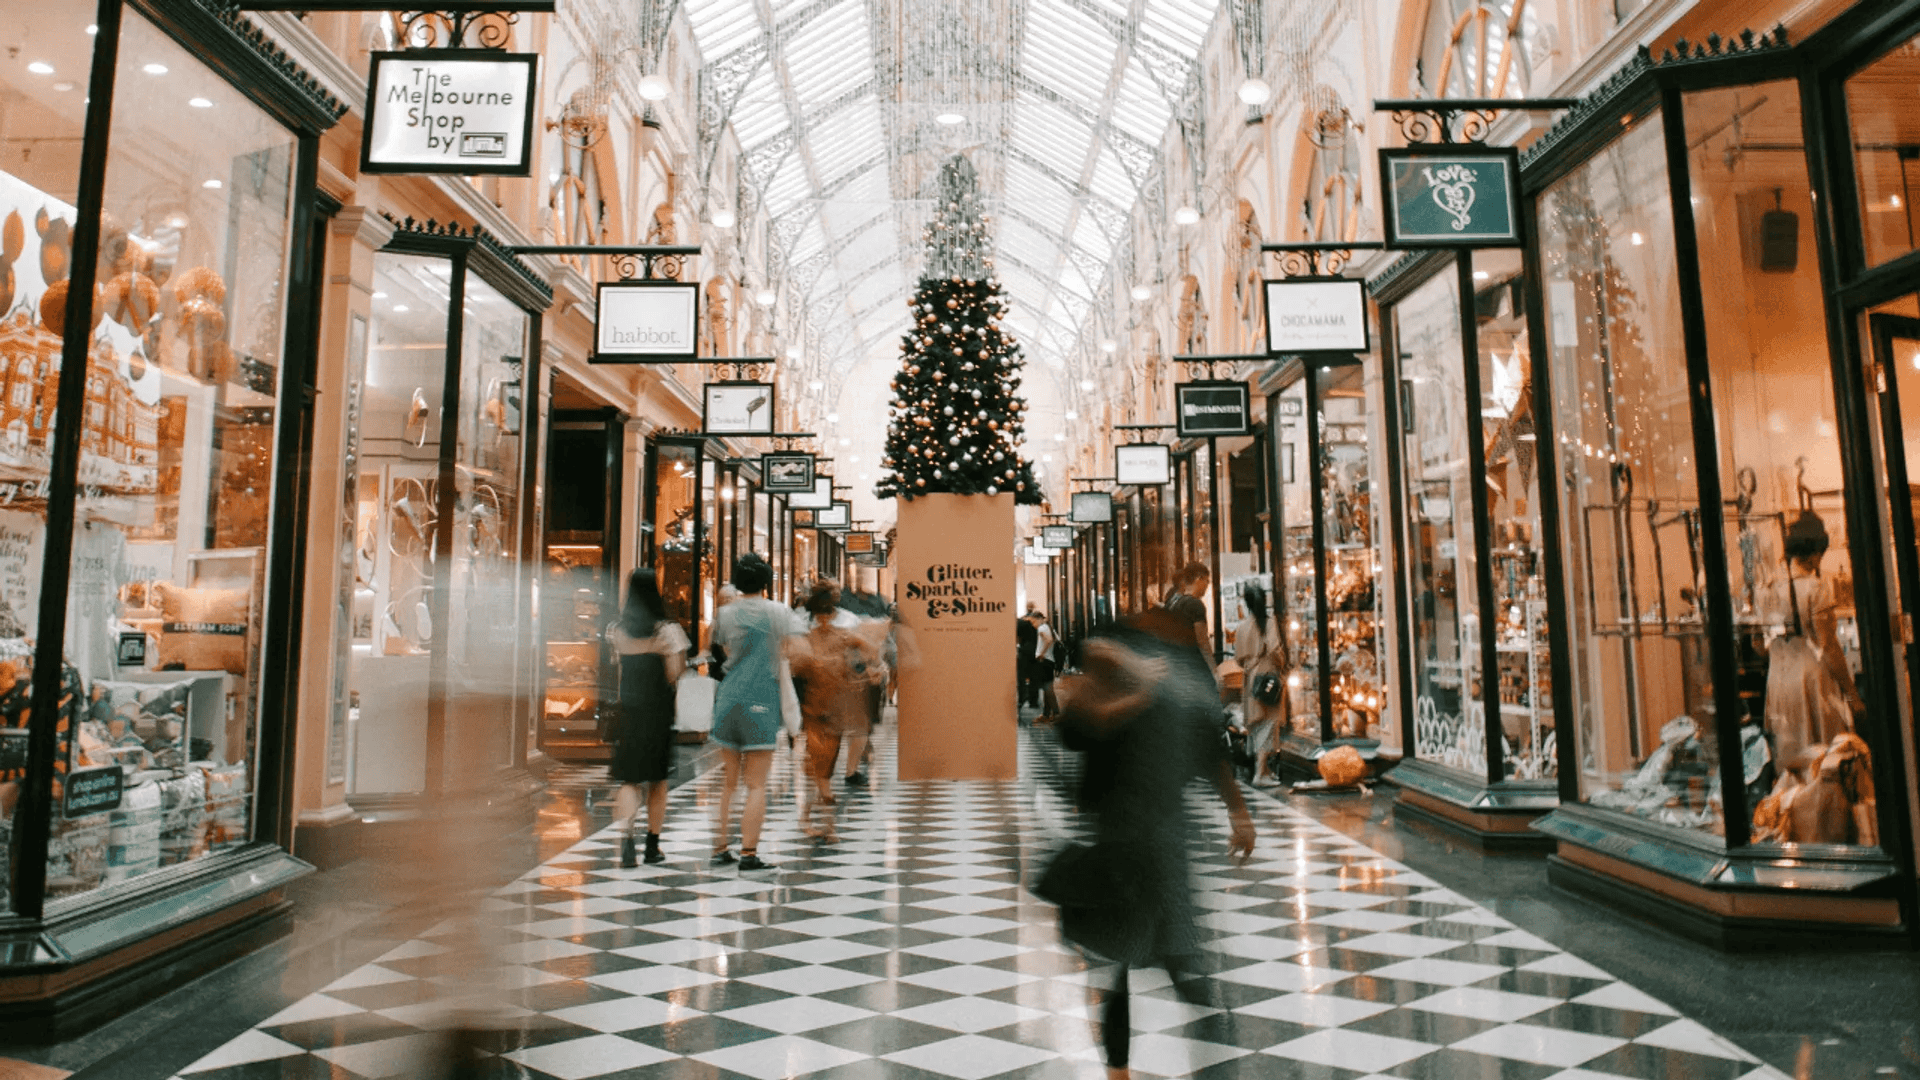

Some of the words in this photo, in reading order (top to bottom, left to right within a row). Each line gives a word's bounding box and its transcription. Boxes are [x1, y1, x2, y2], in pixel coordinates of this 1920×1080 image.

[412, 67, 452, 87] The
[387, 84, 513, 106] Melbourne
[406, 107, 465, 134] Shop
[427, 132, 456, 154] by
[611, 325, 681, 344] habbot.
[927, 563, 993, 583] Glitter.
[906, 580, 979, 600] Sparkle
